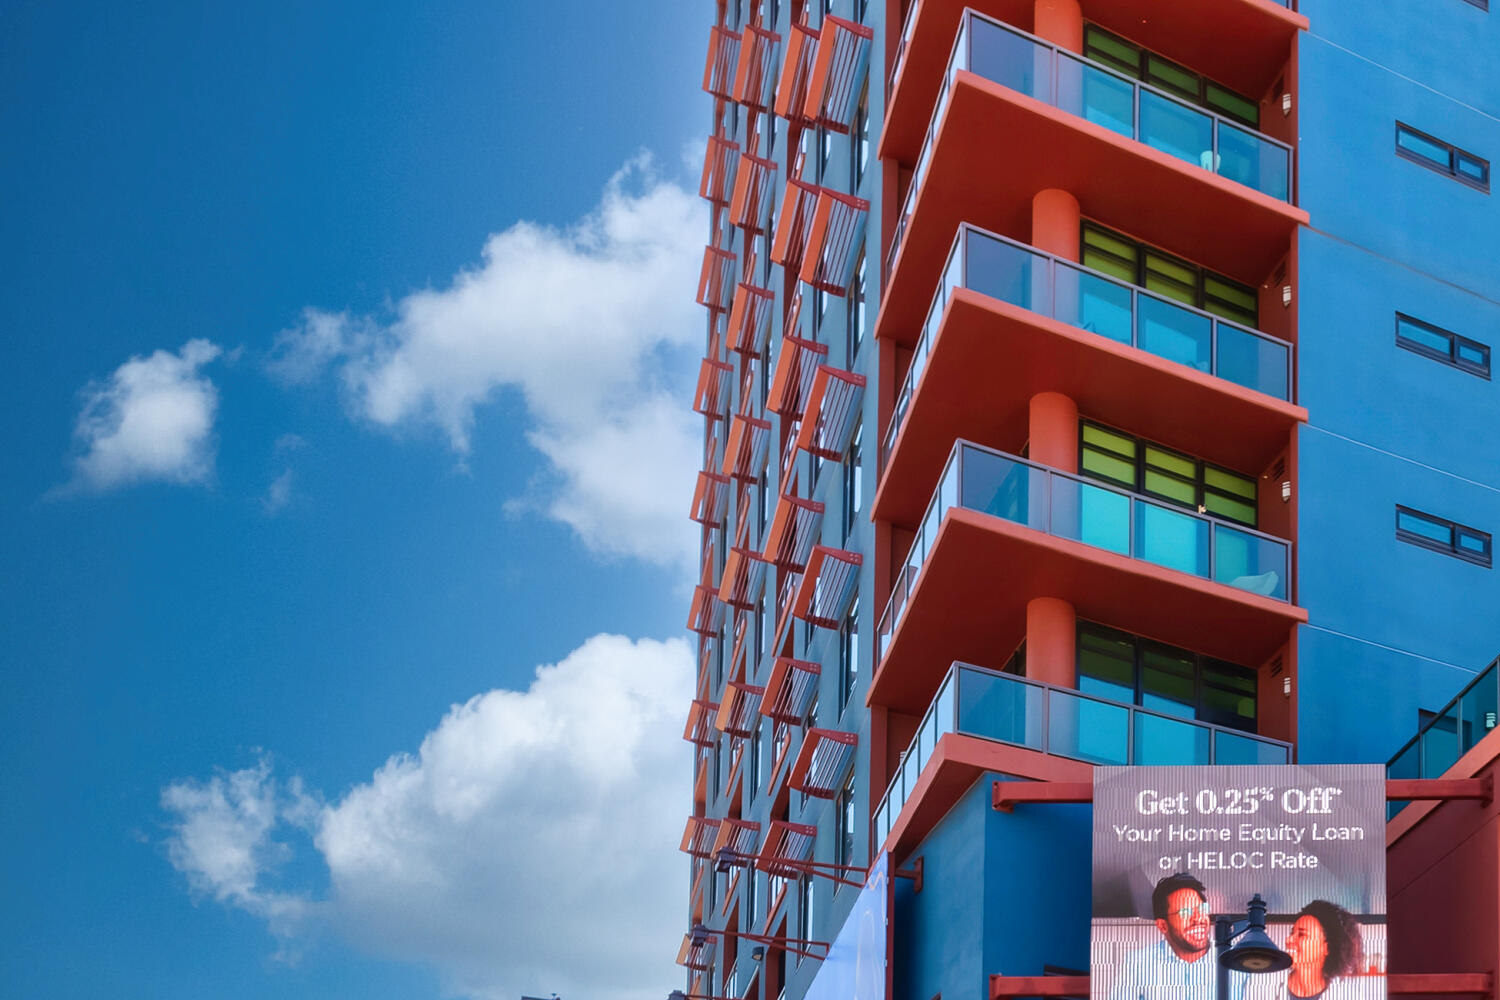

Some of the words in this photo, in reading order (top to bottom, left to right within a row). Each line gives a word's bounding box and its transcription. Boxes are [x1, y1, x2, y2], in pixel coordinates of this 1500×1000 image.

[1137, 788, 1189, 815] Get
[1112, 825, 1161, 842] Your
[1168, 824, 1231, 841] Home
[1238, 824, 1305, 844] Equity
[1312, 823, 1364, 840] Loan
[1159, 855, 1181, 869] or
[1187, 851, 1264, 869] HELOC
[1270, 851, 1318, 869] Rate
